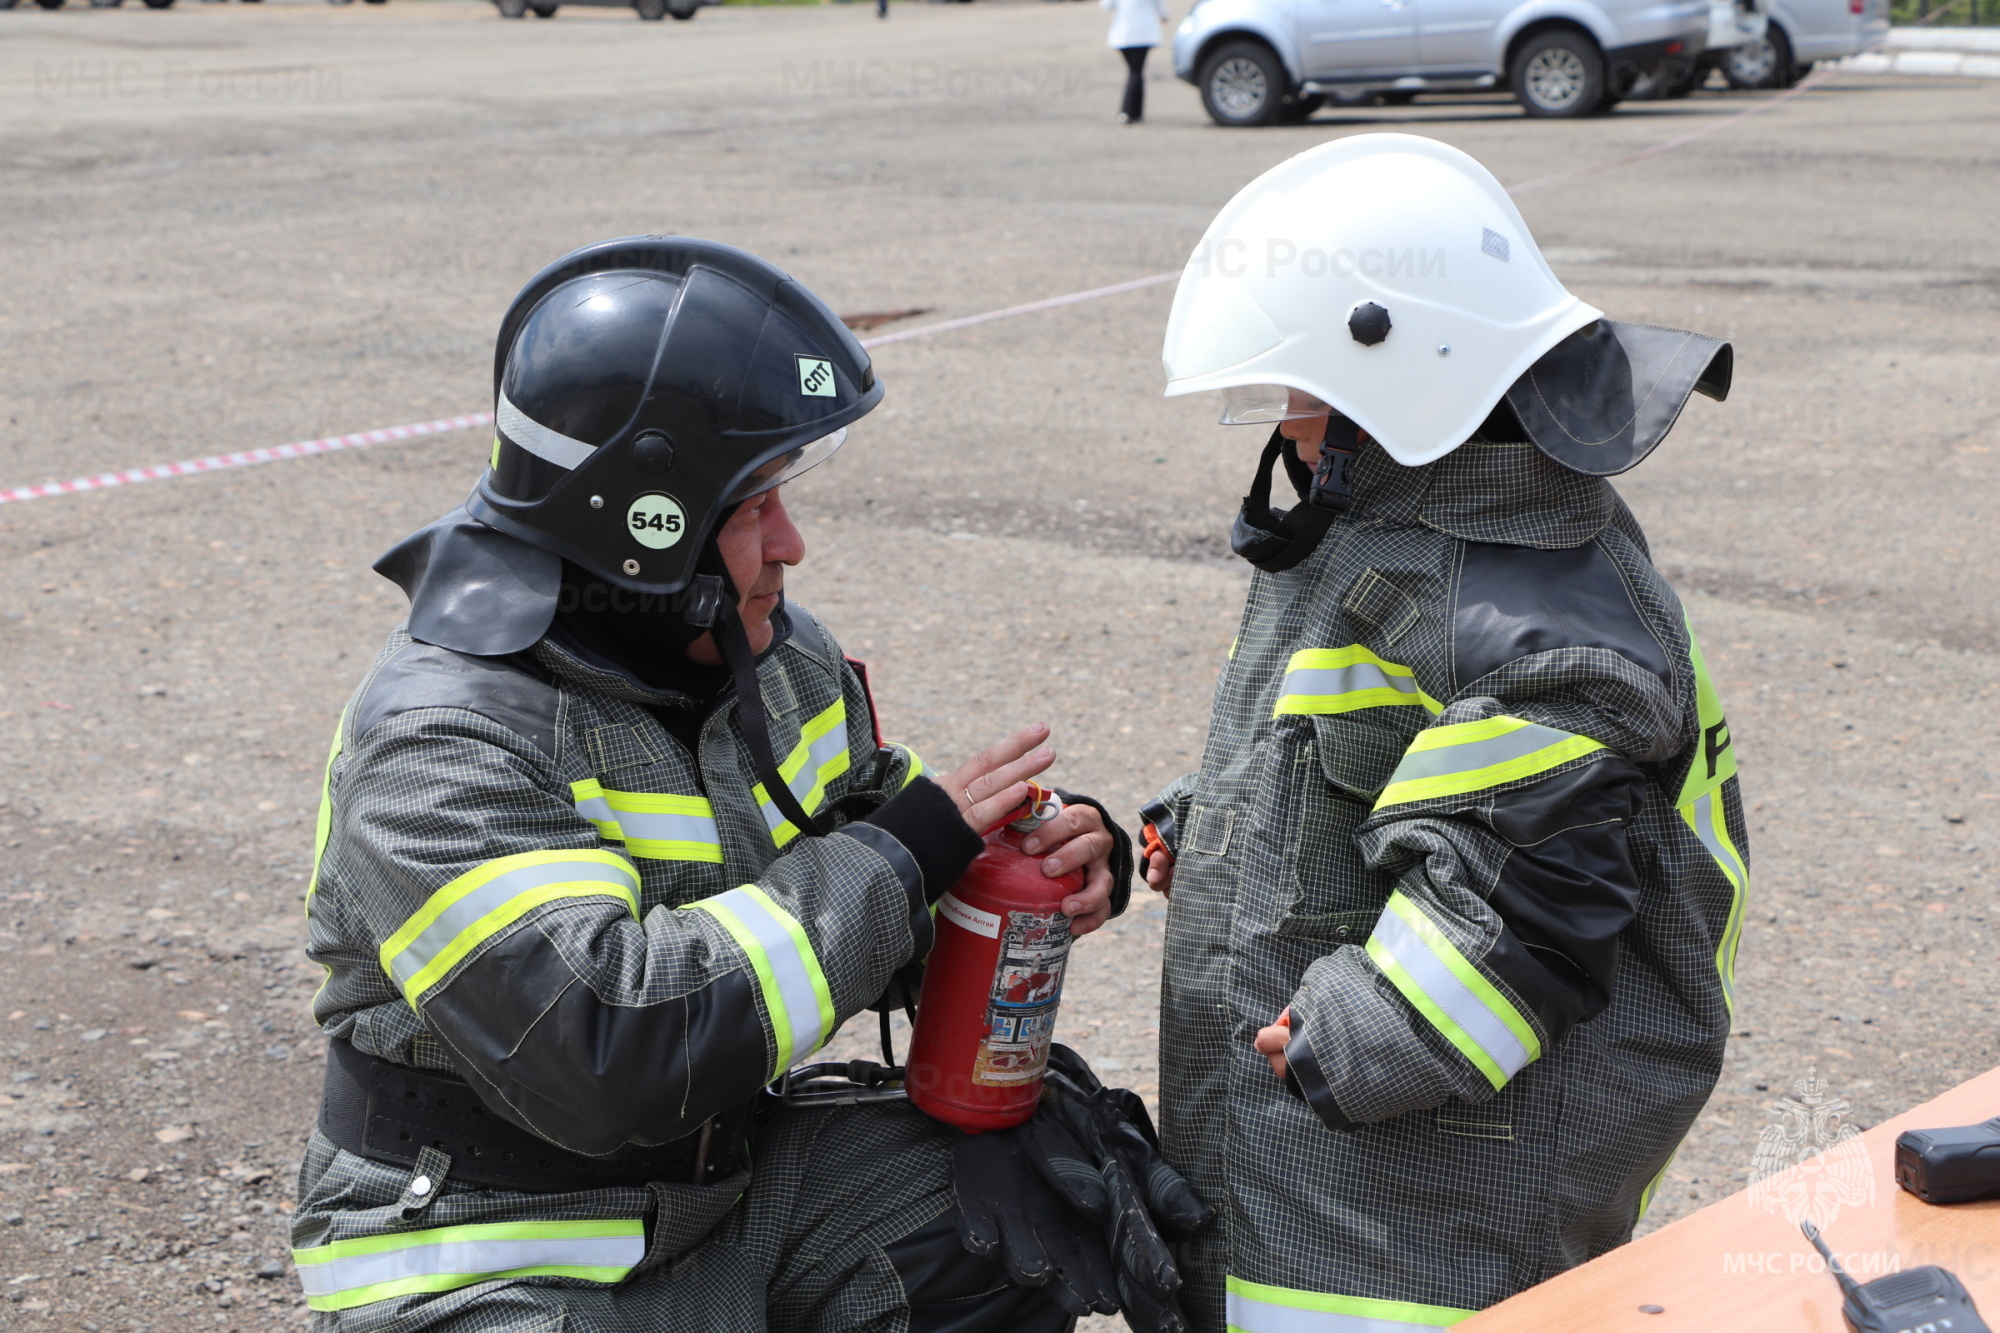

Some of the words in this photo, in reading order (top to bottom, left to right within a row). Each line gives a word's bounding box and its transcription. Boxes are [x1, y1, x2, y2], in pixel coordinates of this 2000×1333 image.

[804, 362, 830, 393] СПТ
[631, 511, 681, 533] 545
[972, 916, 995, 929] Алтай
